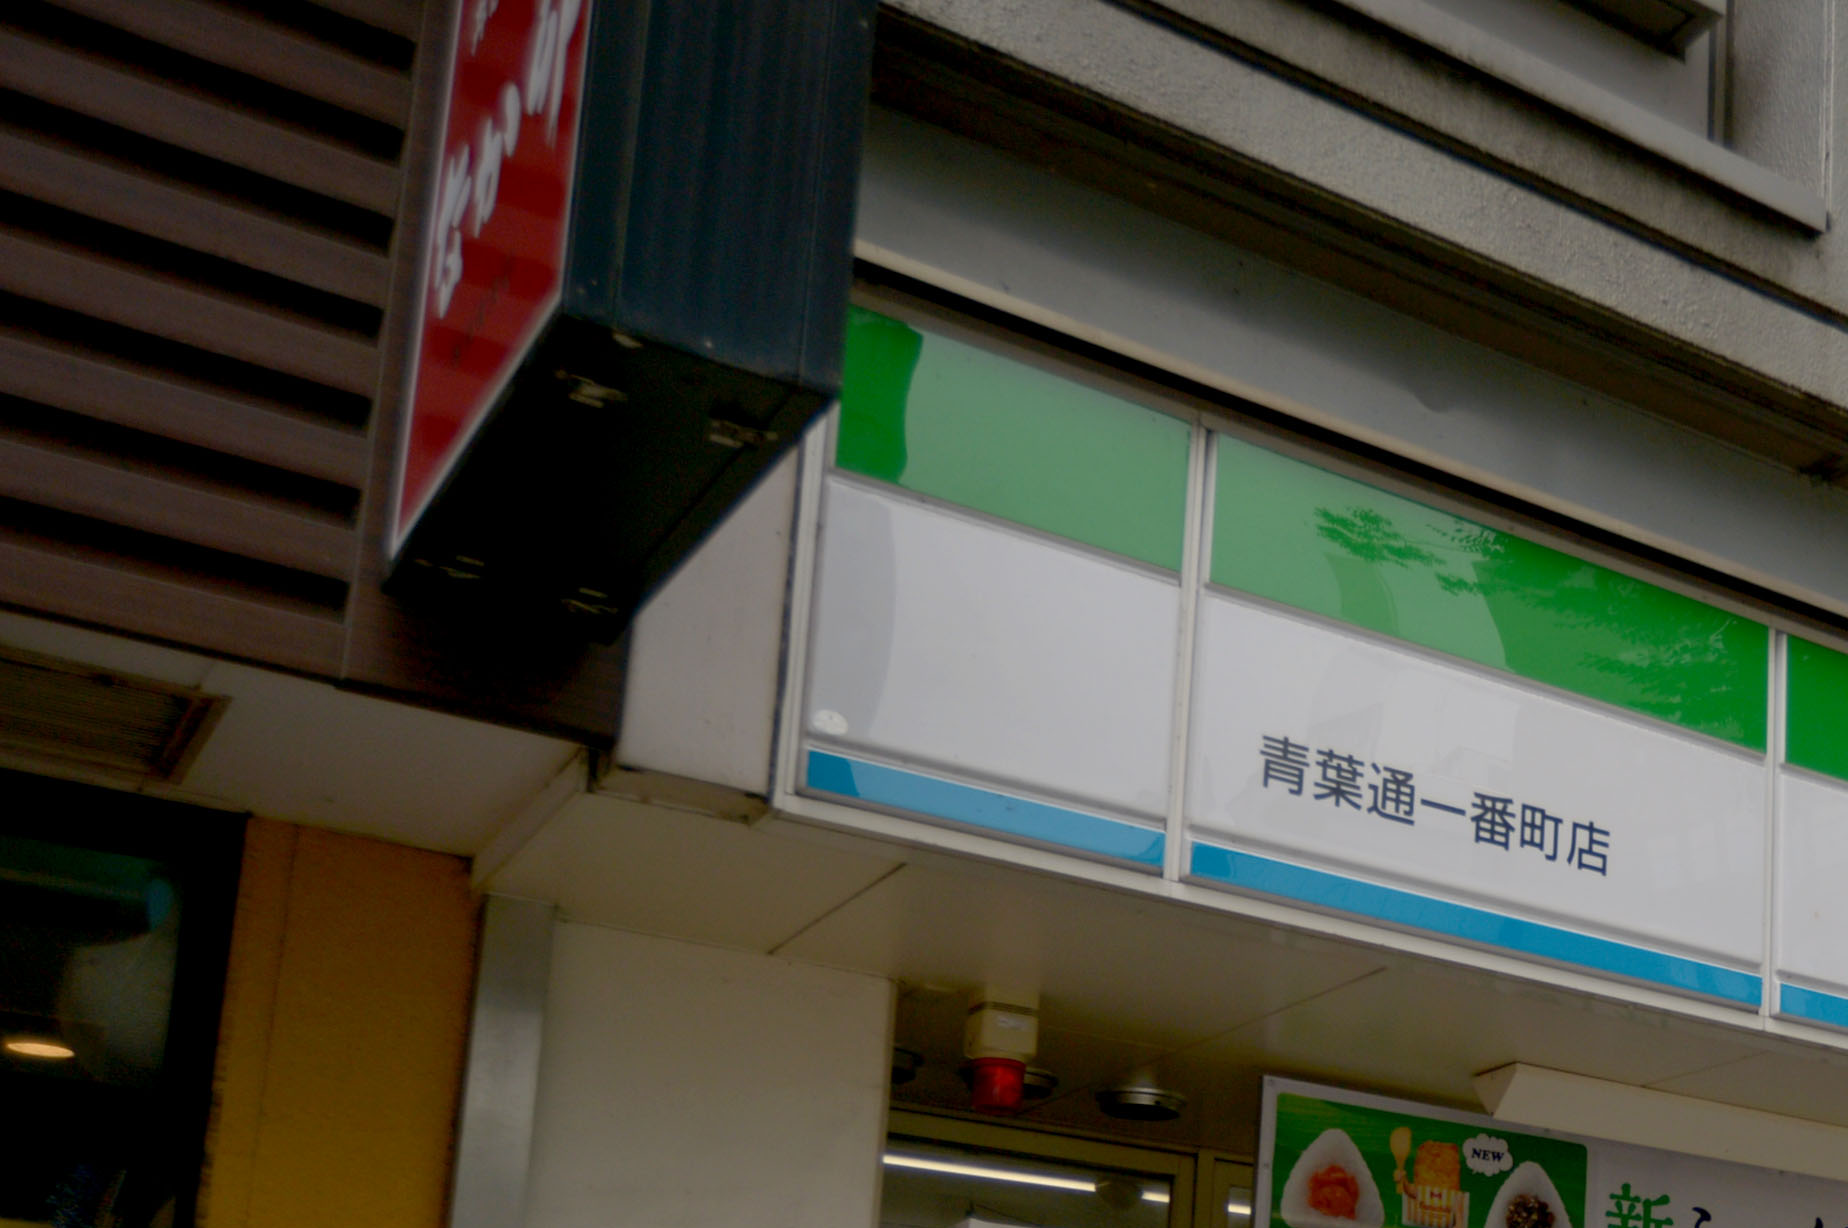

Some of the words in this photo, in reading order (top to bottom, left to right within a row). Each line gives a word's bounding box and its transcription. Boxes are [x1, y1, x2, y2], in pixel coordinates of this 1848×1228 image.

[1259, 735, 1611, 876] 青葉通一番町店
[1471, 1147, 1504, 1163] NEW
